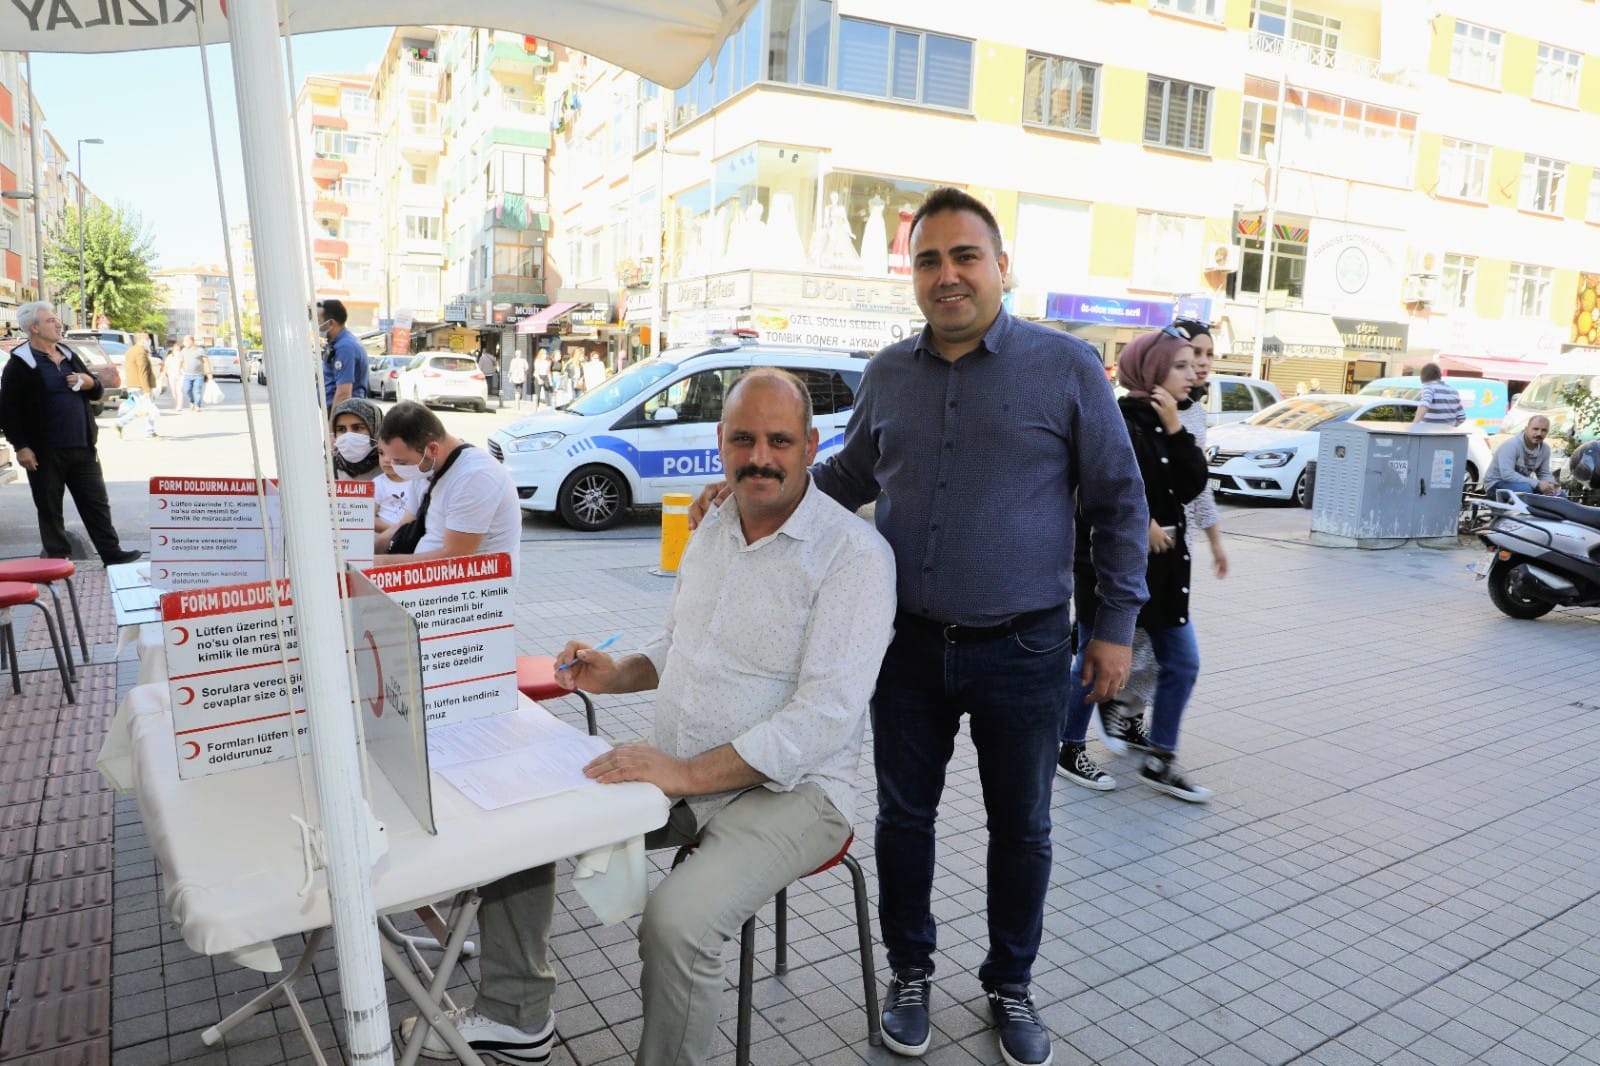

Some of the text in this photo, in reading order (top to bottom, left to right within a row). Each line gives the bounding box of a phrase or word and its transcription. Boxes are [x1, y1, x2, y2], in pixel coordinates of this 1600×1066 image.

[849, 337, 880, 348] AYRAN
[663, 455, 723, 475] POLİS
[159, 480, 255, 492] FORM DOLDURMA ALANI
[344, 484, 367, 494] ALANI
[370, 559, 498, 589] FORM DOLDURMA ALANI
[180, 594, 219, 614] FORM
[418, 594, 459, 607] üzerinde
[461, 591, 478, 601] T.C.
[481, 586, 509, 599] Kimlik
[415, 601, 484, 619] olan resimli bir
[431, 615, 475, 629] müracaat
[476, 610, 504, 622] ediniz
[196, 623, 233, 638] Lütfen
[237, 617, 283, 632] üzerind
[197, 638, 230, 651] no'su
[232, 634, 257, 645] olan
[432, 643, 484, 660] vereceğiniz
[199, 650, 233, 664] kimlik
[235, 648, 250, 658] ile
[432, 660, 451, 671] size
[453, 654, 484, 667] özeldir
[202, 682, 251, 698] Sorulara
[203, 694, 251, 711] cevaplar
[254, 688, 276, 701] size
[434, 696, 460, 710] lütfen
[462, 689, 500, 704] kendiniz
[207, 736, 255, 753] Formları
[257, 729, 289, 744] lütfen
[208, 744, 273, 765] doldurunuz
